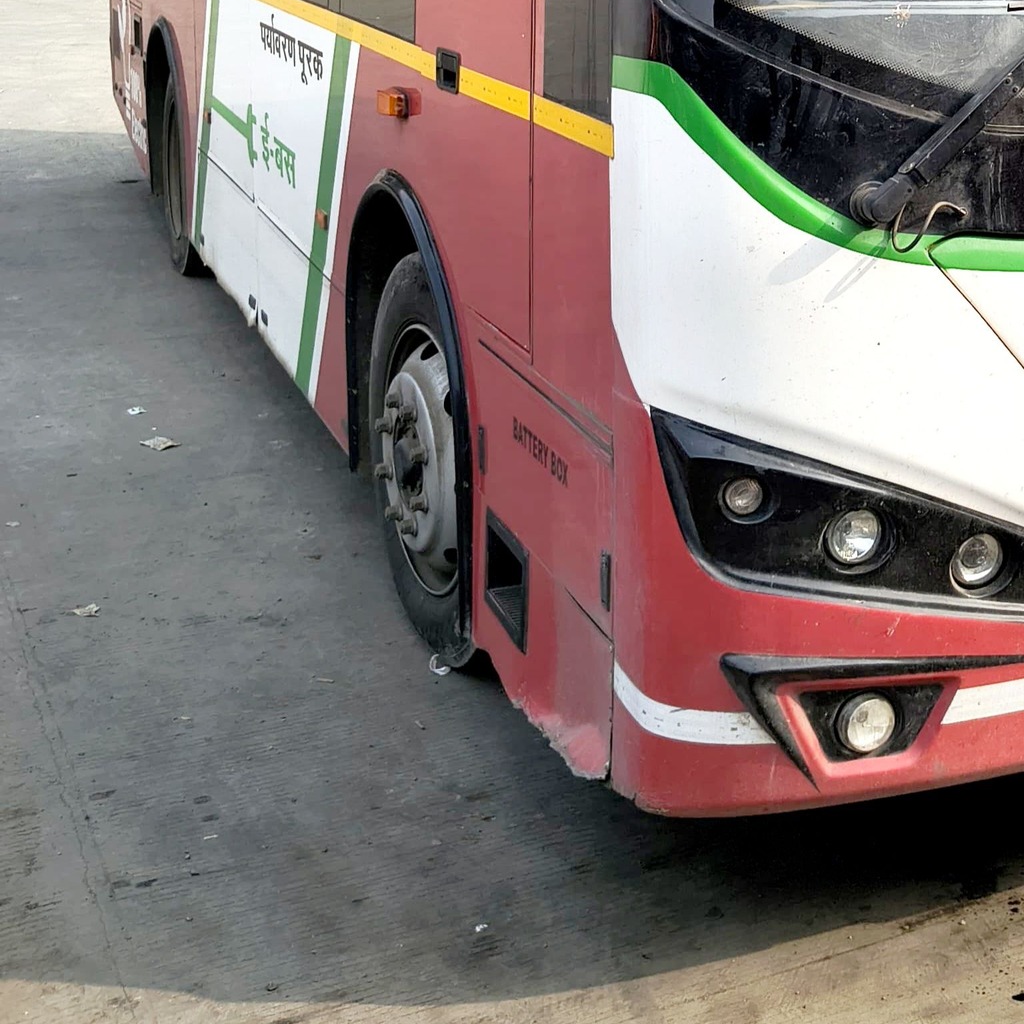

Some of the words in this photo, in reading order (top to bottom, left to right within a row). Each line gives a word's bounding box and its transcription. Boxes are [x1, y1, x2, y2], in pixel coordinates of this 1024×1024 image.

[259, 13, 297, 67] पर्यावरण
[298, 39, 323, 85] पूरक
[512, 416, 549, 469] BATTERY
[550, 450, 569, 488] BOX
